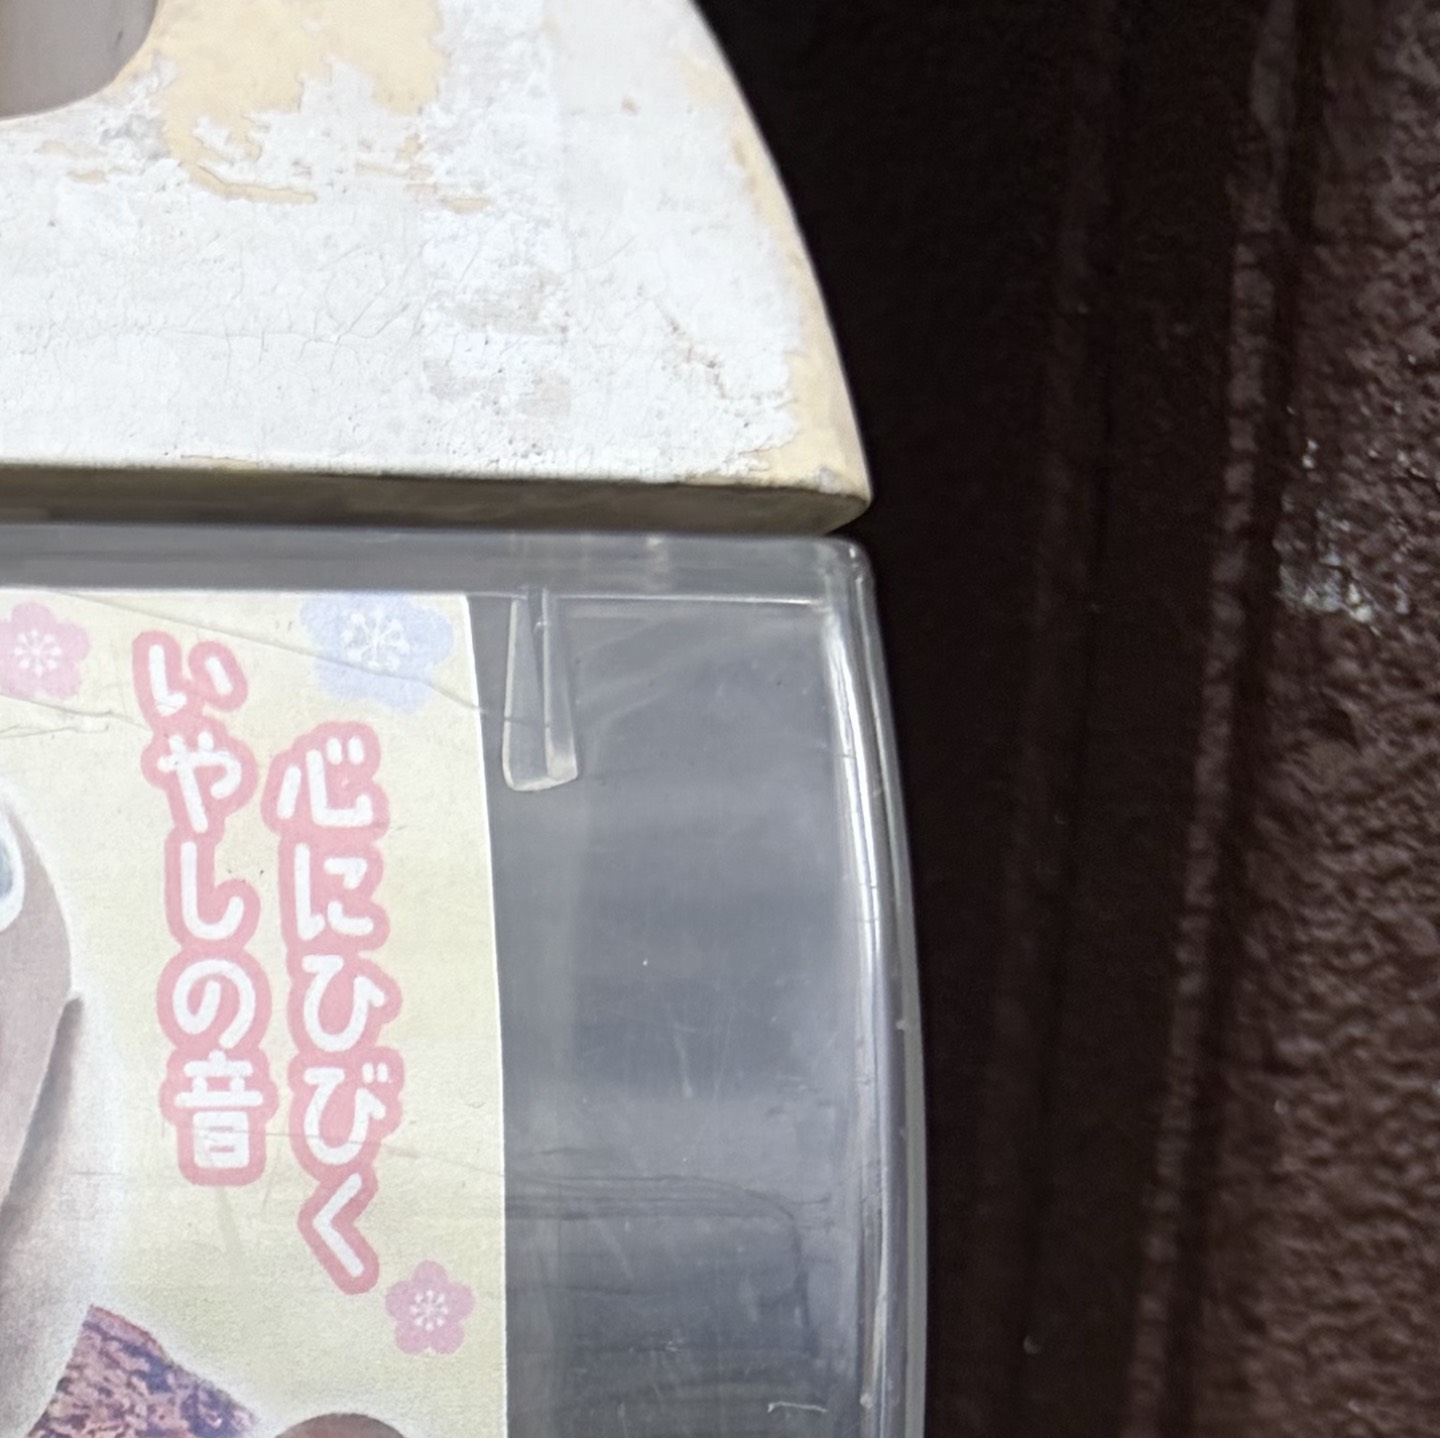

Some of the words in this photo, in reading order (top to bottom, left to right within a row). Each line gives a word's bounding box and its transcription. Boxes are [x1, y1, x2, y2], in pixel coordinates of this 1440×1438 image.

[140, 638, 270, 1178] いやしの音
[270, 730, 395, 1285] 心にひびく
